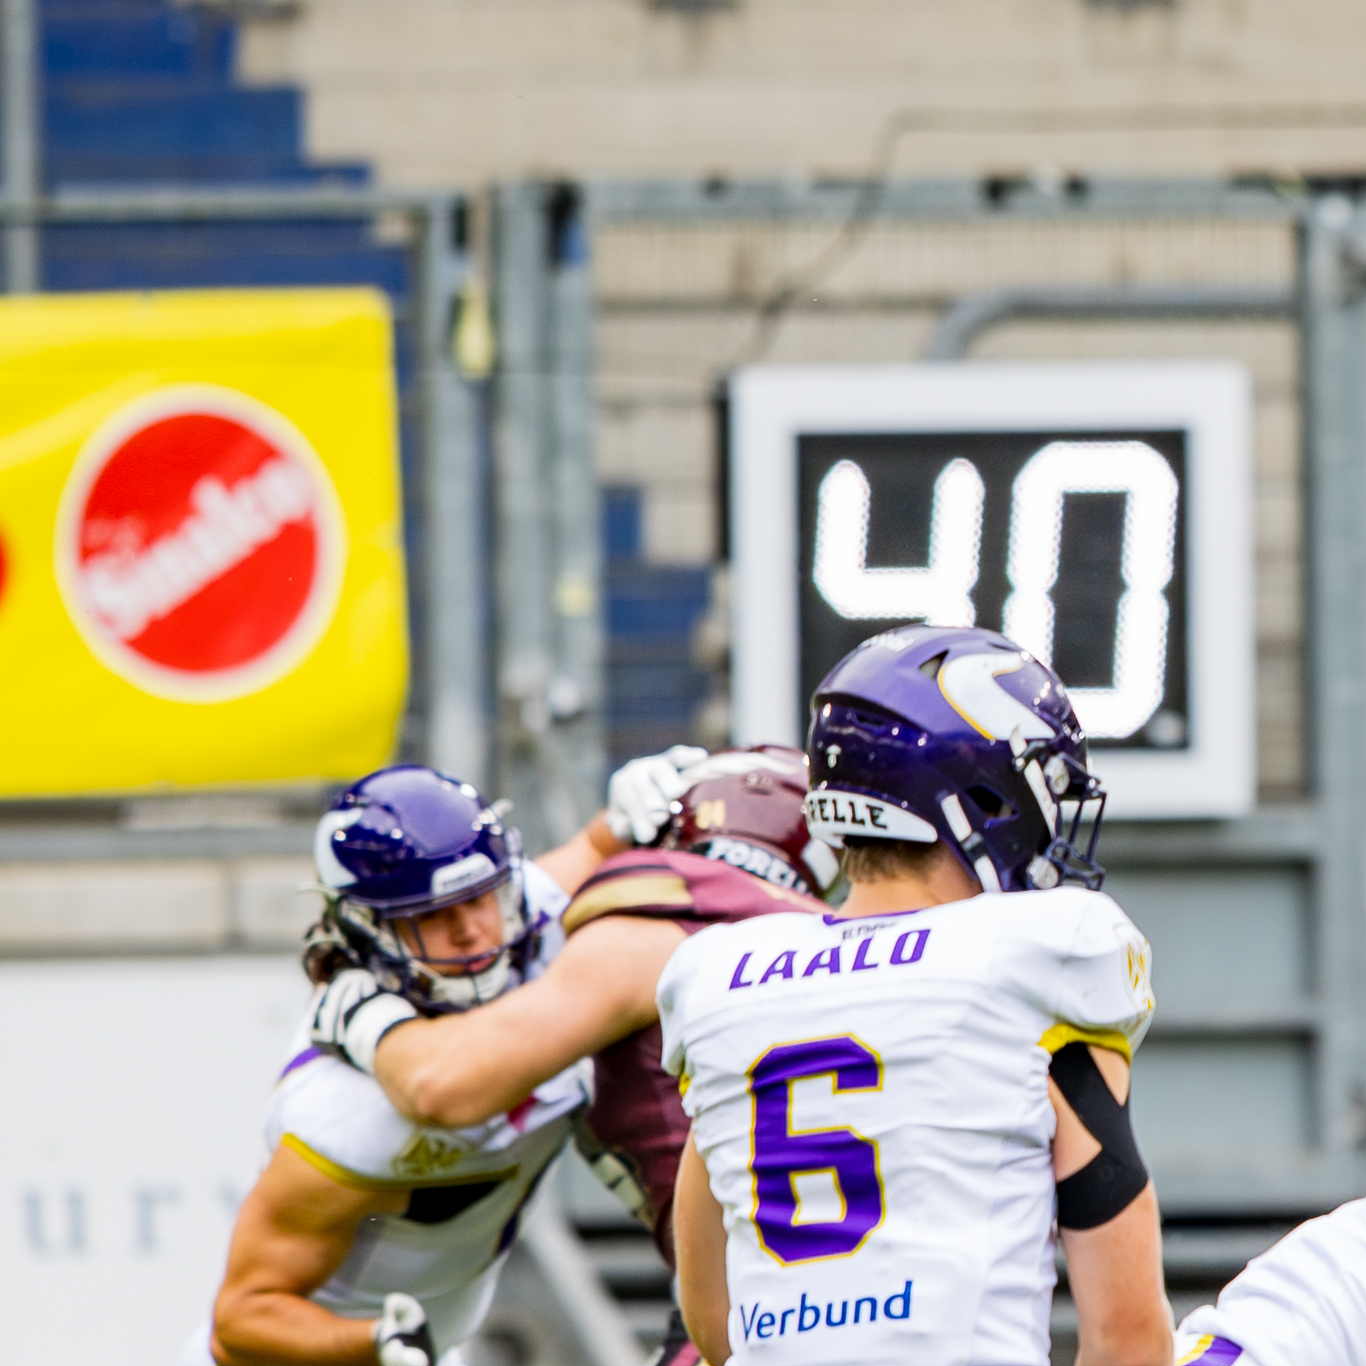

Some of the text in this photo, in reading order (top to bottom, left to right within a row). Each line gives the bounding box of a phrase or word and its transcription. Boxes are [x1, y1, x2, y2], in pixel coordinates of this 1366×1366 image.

[813, 440, 1180, 739] 40
[728, 928, 933, 991] LAALO
[744, 1031, 886, 1268] 6
[739, 1279, 914, 1344] Verbund
